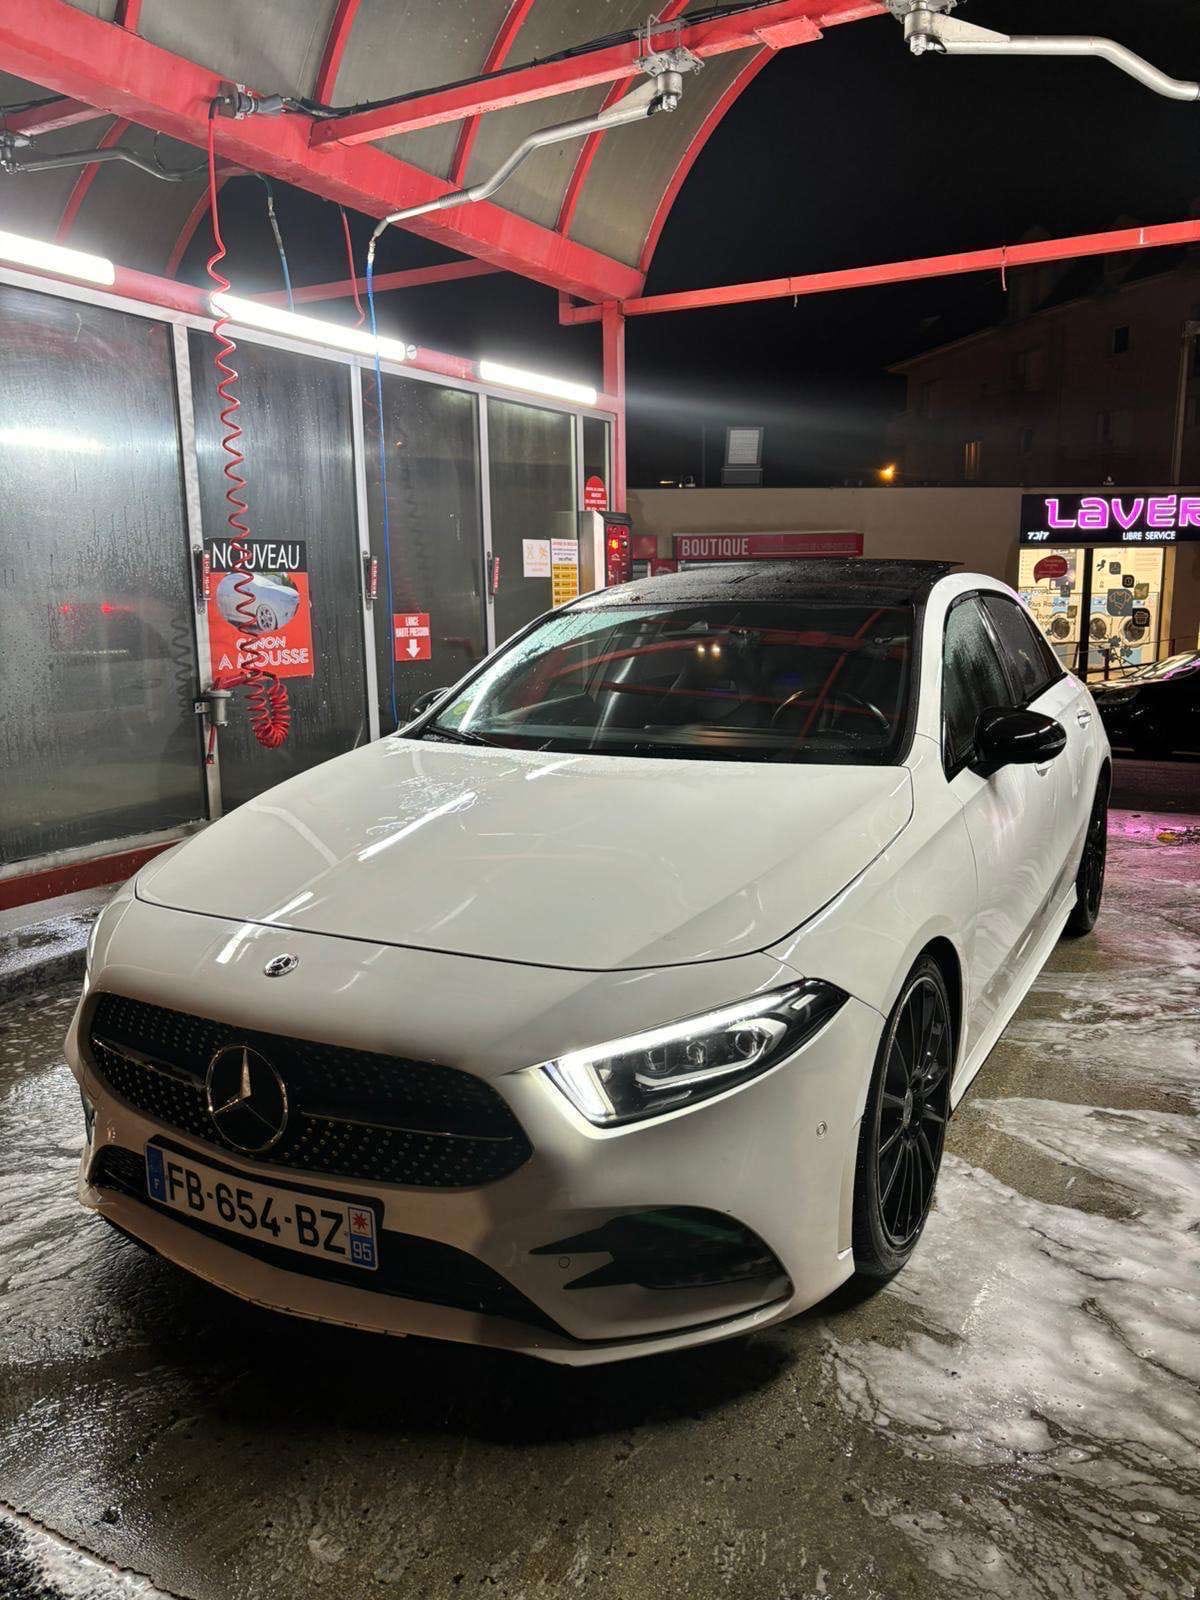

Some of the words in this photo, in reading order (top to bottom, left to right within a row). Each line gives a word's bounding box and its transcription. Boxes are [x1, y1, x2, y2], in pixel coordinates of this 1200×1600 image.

[1122, 531, 1142, 541] LIBRE
[1145, 531, 1176, 541] SERVICE
[212, 542, 300, 569] NOUVEAU
[682, 538, 749, 556] BOUTIQUE
[218, 653, 234, 671] A
[352, 1240, 373, 1261] 95
